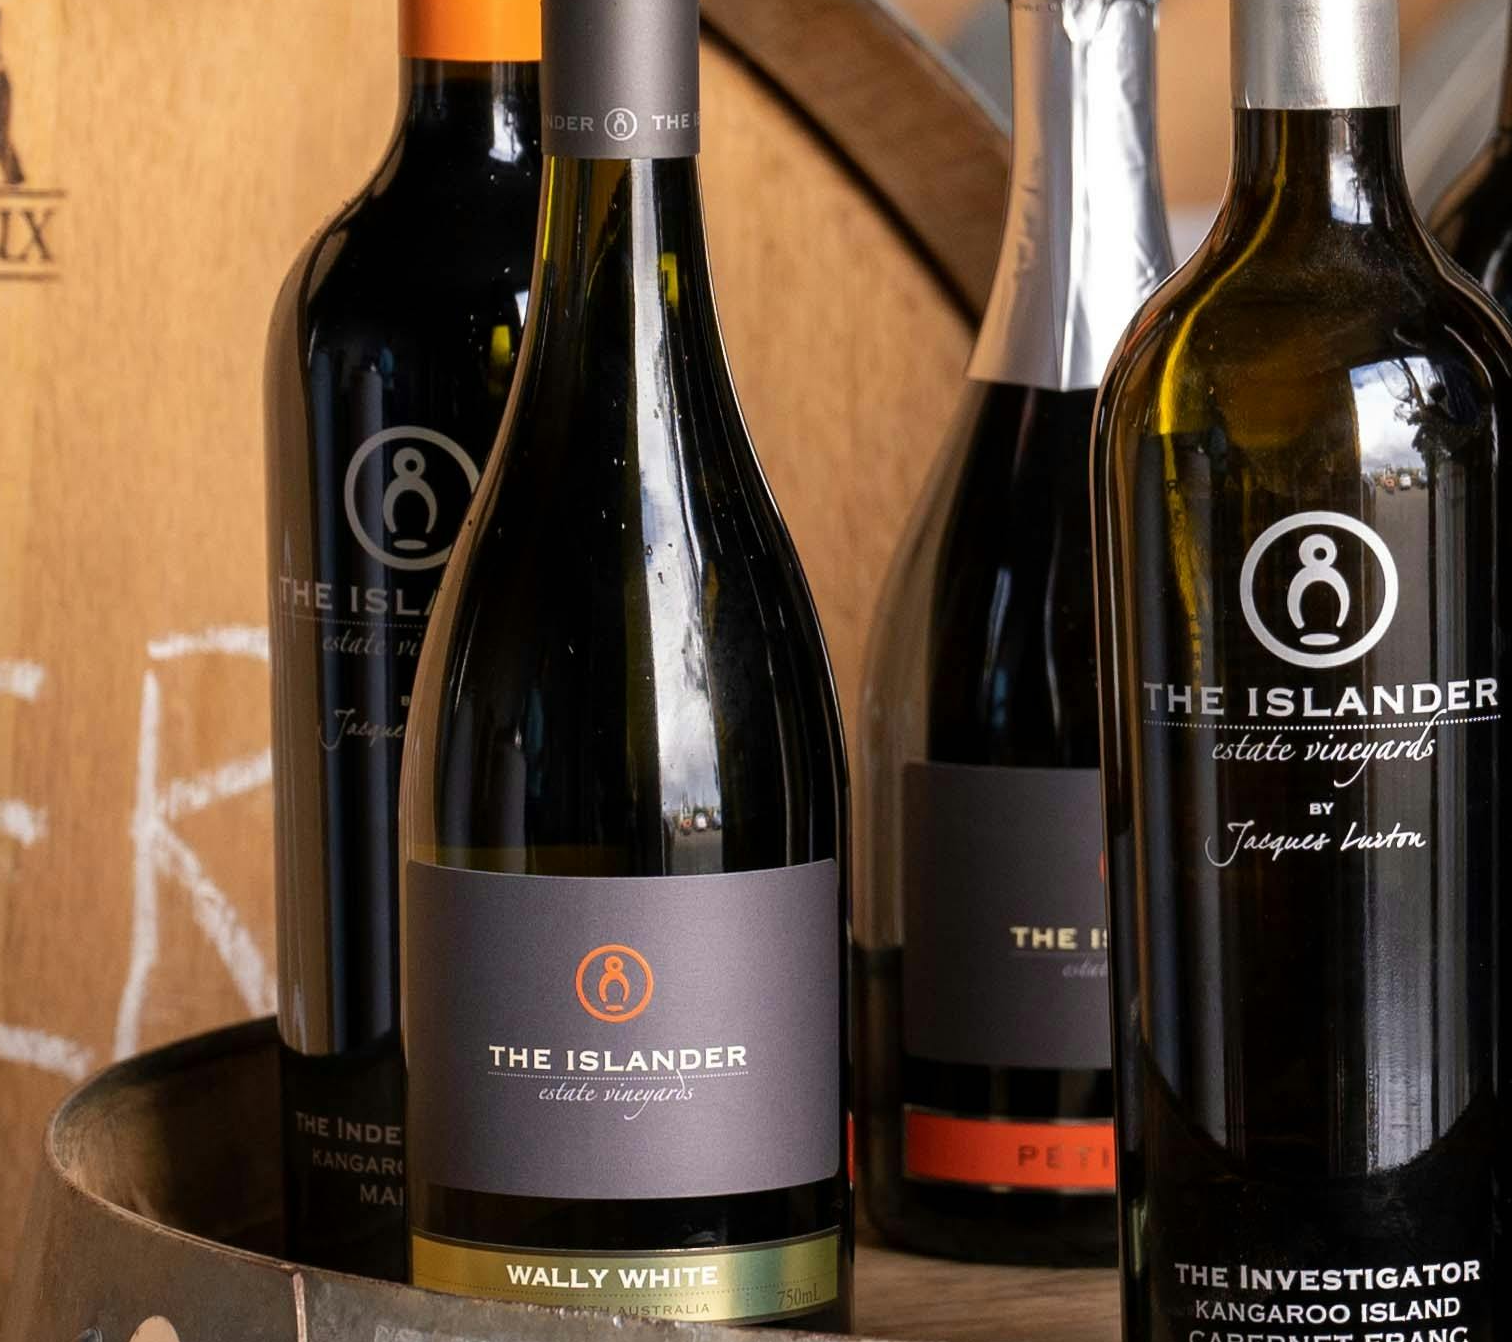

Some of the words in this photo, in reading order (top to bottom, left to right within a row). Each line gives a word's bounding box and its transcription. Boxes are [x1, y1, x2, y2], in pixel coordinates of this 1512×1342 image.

[651, 112, 690, 131] THE
[278, 576, 334, 610] THE
[322, 628, 388, 657] estate
[1143, 681, 1225, 716] THE
[1247, 677, 1499, 717] ISLANDER
[1211, 733, 1296, 762] estate
[1303, 708, 1447, 788] vineyards
[1309, 802, 1335, 816] BY
[1204, 820, 1331, 868] Jacques
[1340, 821, 1426, 852] Lurton
[1010, 926, 1078, 950] THE
[488, 1044, 552, 1071] THE
[566, 1044, 748, 1072] ISLANDER
[539, 1082, 598, 1102] estate
[603, 1068, 695, 1121] vineyards
[295, 1110, 329, 1137] THE
[506, 1264, 609, 1289] WALLY
[618, 1265, 719, 1289] WHITE
[1174, 1262, 1229, 1288] THE
[1239, 1259, 1481, 1291] INVESTIGATOR
[617, 1303, 710, 1316] AUSTRALIA
[776, 1282, 821, 1309] 750mL
[1195, 1299, 1351, 1324] KANGAROO
[1361, 1296, 1461, 1324] ISLAND
